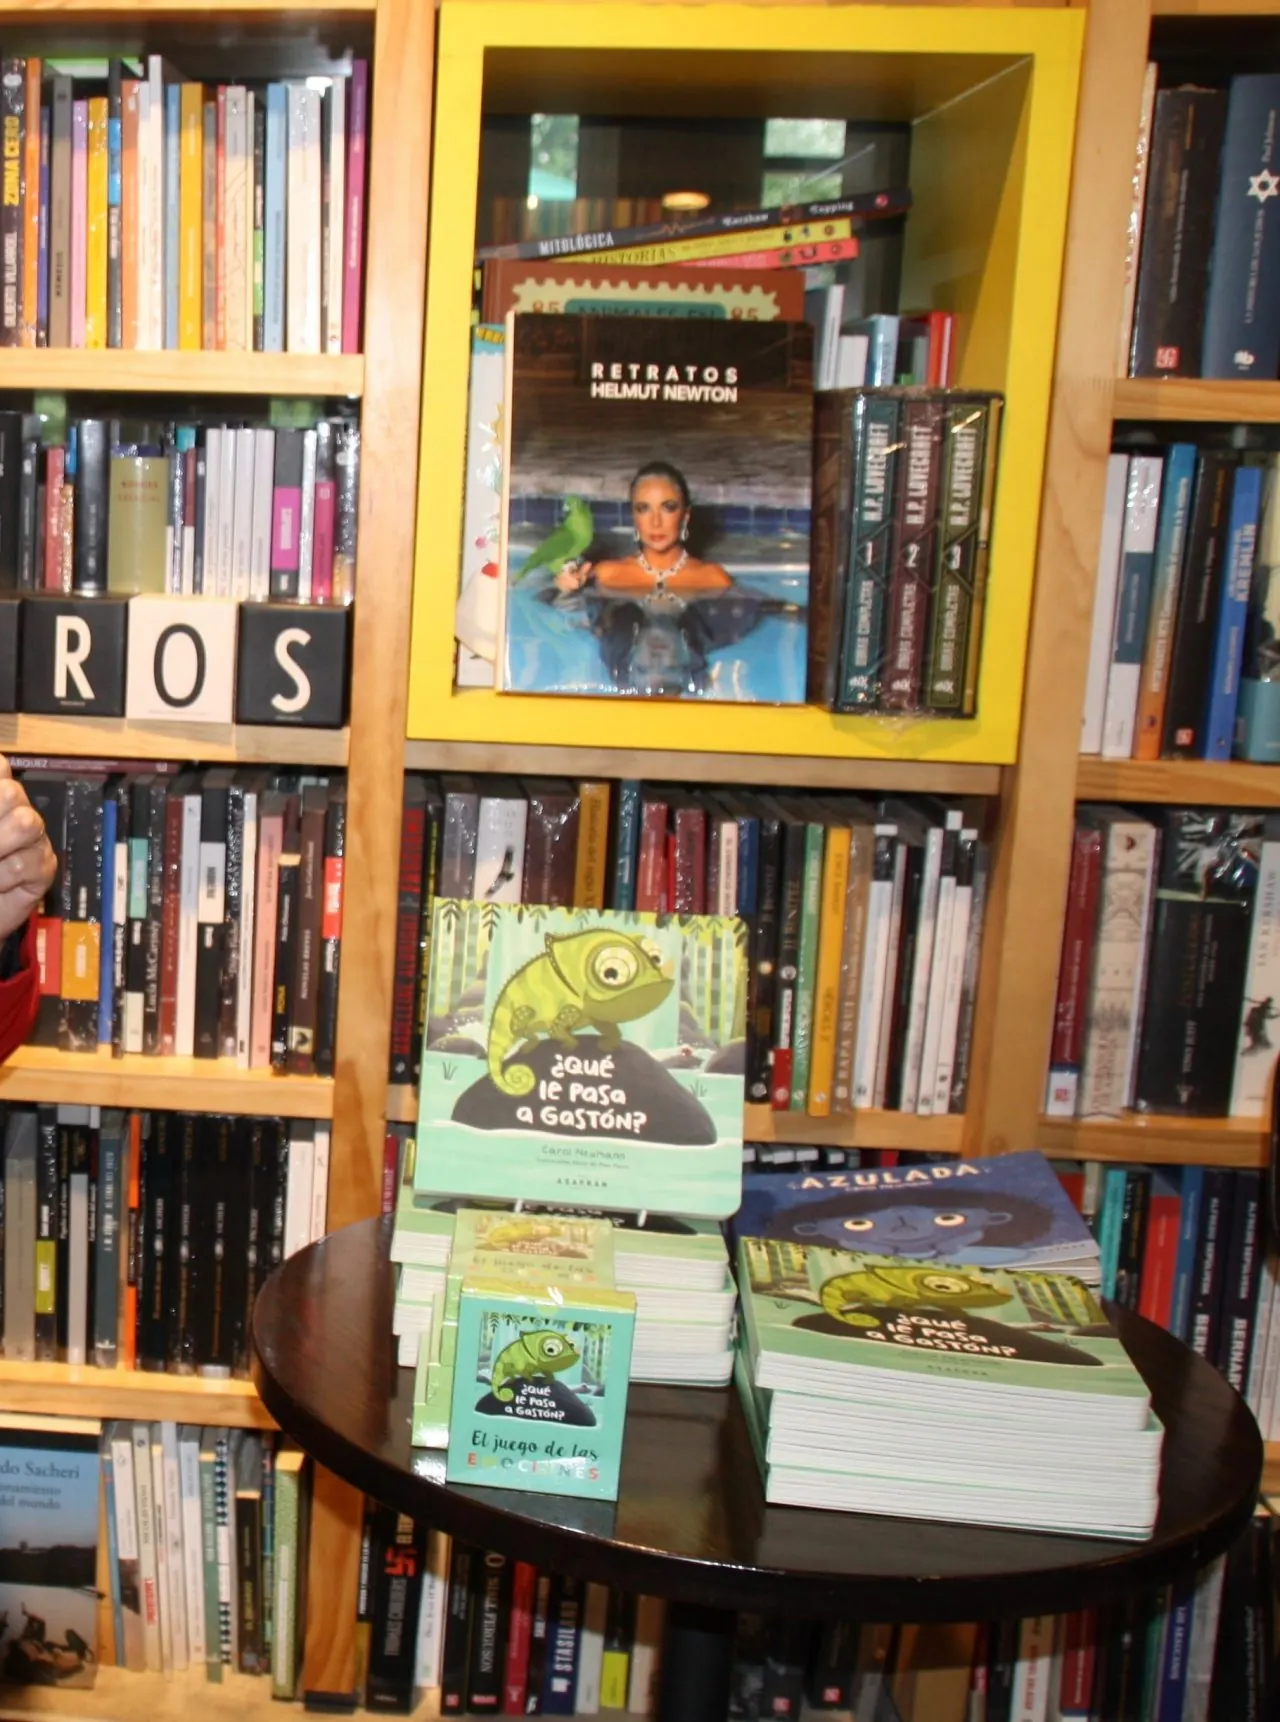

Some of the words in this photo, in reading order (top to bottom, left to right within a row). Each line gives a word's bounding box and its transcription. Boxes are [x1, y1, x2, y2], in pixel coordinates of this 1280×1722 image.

[539, 231, 615, 256] MITOLÓGICA
[591, 362, 739, 385] RETRATOS
[590, 381, 660, 401] HELMUT
[663, 384, 739, 404] NEWTON
[550, 1053, 616, 1080] ¿Qué
[539, 1079, 566, 1102] le
[516, 1107, 534, 1126] a
[801, 1164, 980, 1190] AZULADA
[886, 1322, 913, 1334] le
[896, 1312, 968, 1331] ¿Qué
[1227, 1317, 1248, 1392] BERNAR
[515, 1395, 527, 1406] le
[521, 1383, 552, 1398] ¿Qué
[472, 1429, 489, 1448] El
[493, 1434, 539, 1456] juego
[545, 1440, 567, 1458] de
[572, 1443, 600, 1462] las
[24, 1460, 80, 1480] Sacheri
